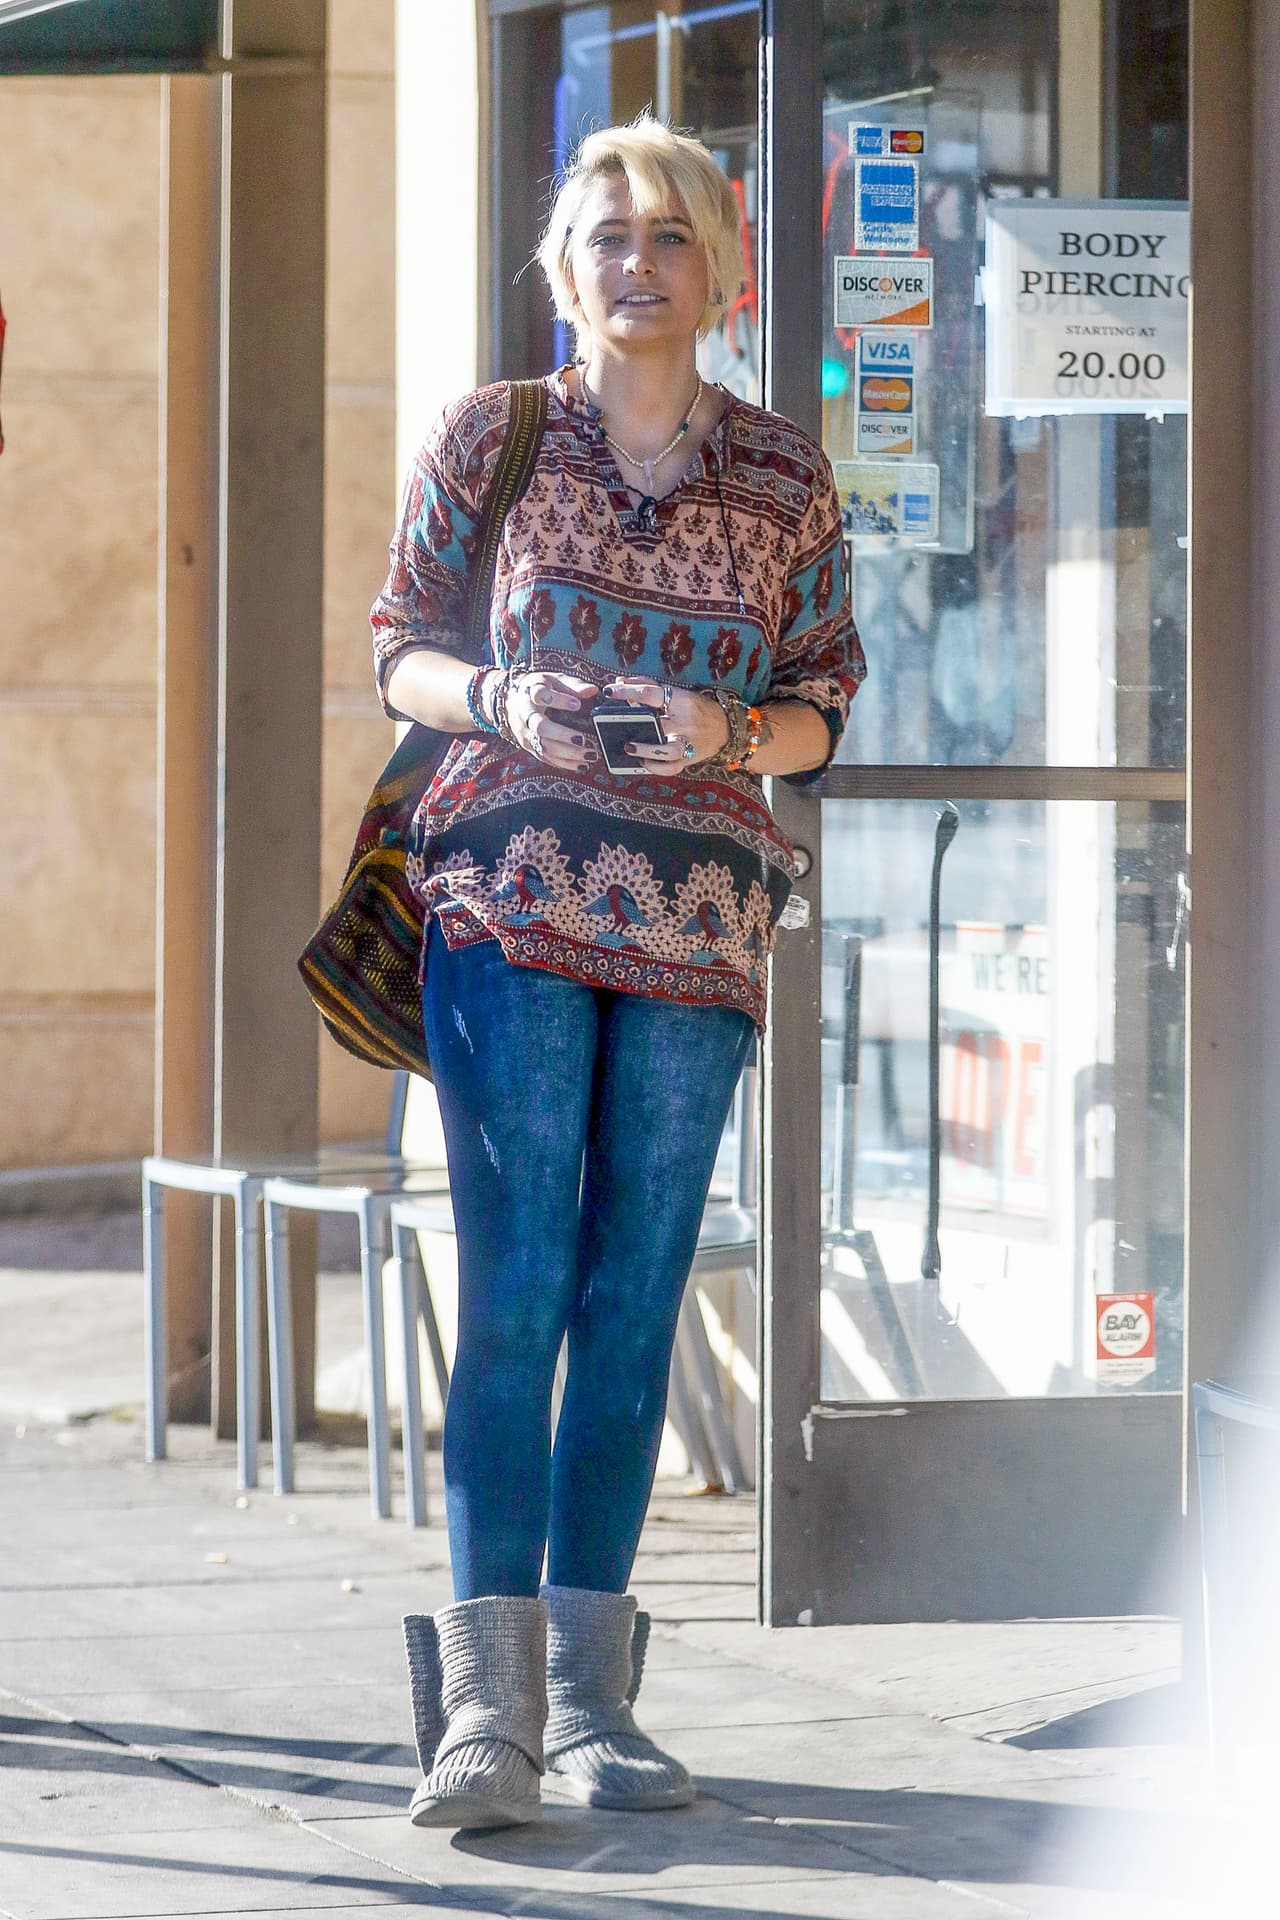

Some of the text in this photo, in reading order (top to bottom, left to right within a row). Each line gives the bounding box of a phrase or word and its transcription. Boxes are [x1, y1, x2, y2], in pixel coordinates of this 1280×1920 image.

[863, 223, 892, 233] Cards
[863, 234, 910, 243] Welcome
[1058, 232, 1167, 258] BODY
[843, 276, 924, 293] DISCOVER
[1065, 325, 1158, 337] STARTING AT
[868, 342, 911, 360] VISA
[1057, 351, 1166, 380] 20.00
[861, 423, 908, 435] DISCOVER
[971, 953, 1048, 995] WE'RE
[952, 1029, 1046, 1177] OPE
[1105, 1313, 1142, 1331] BAY
